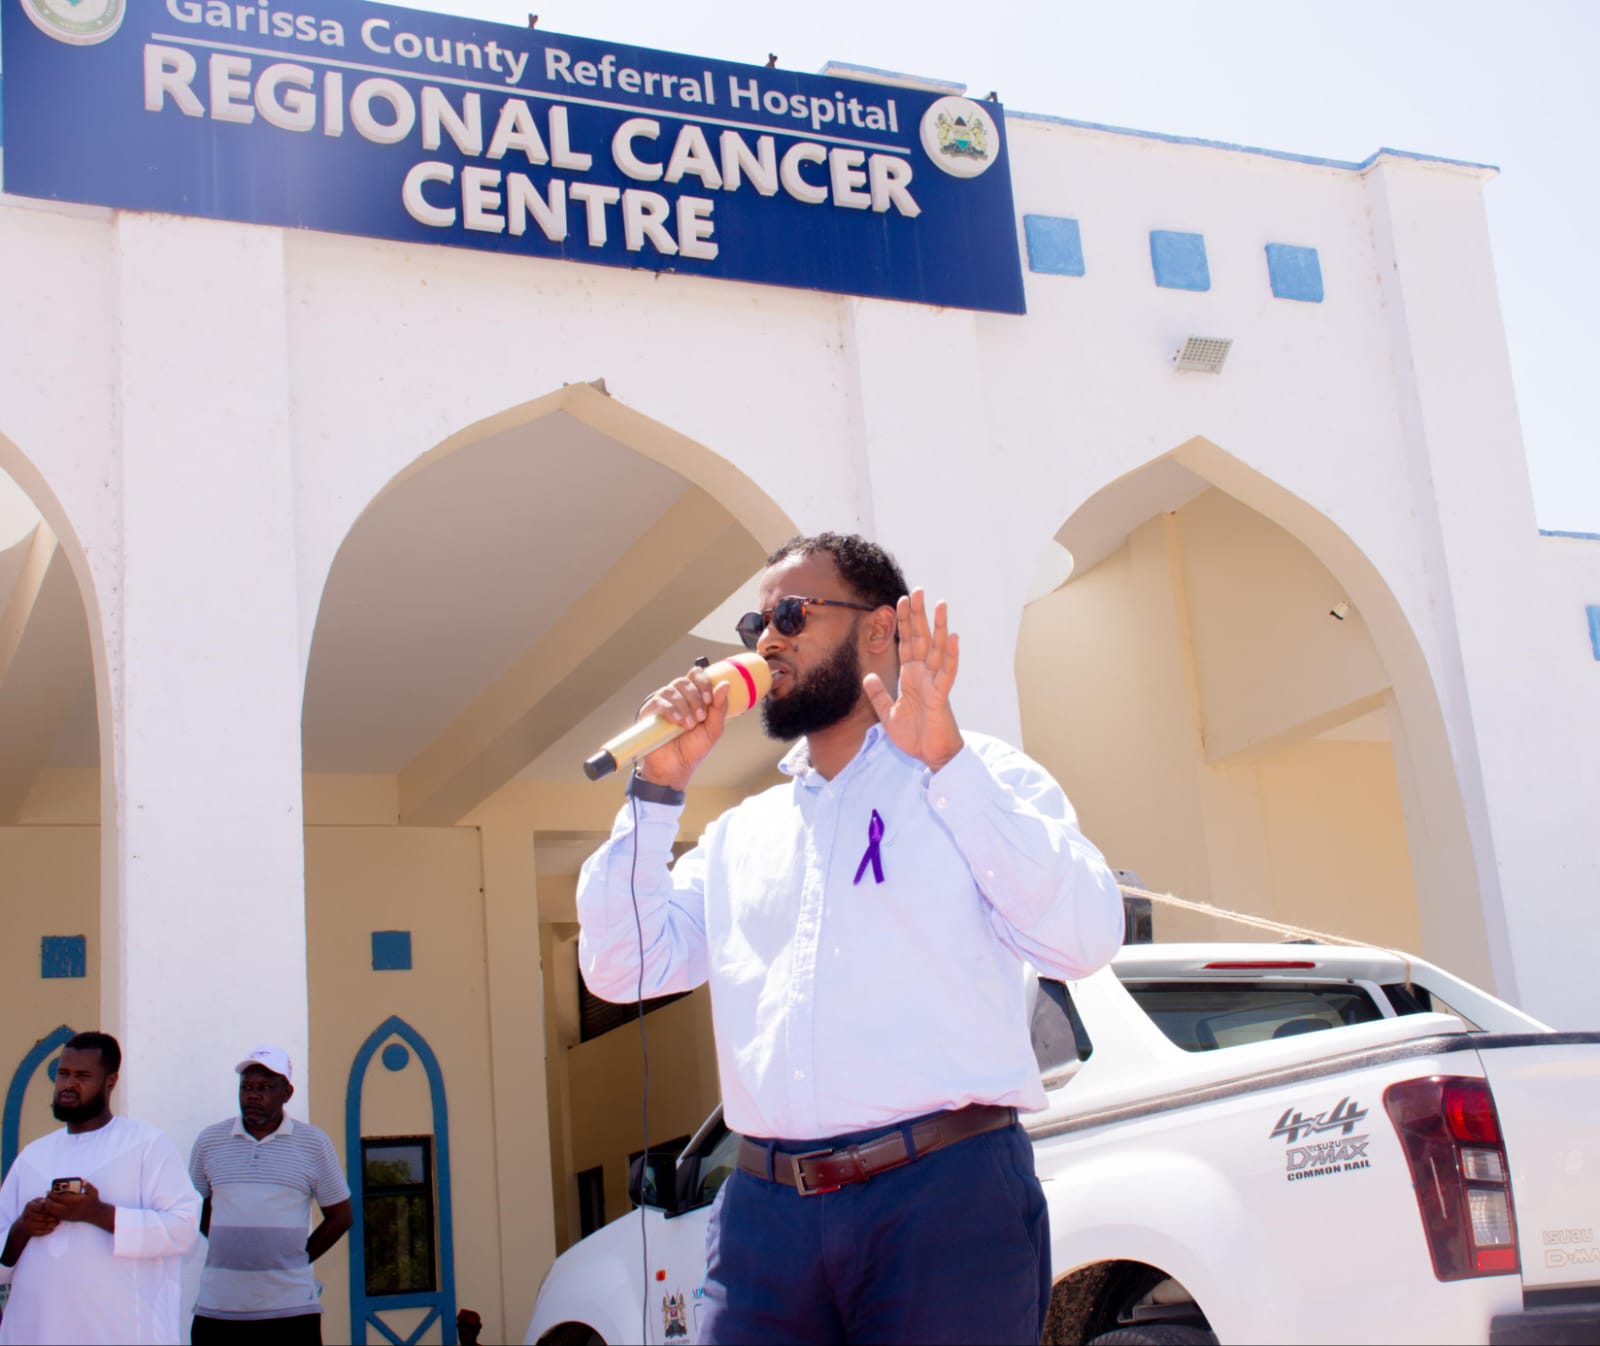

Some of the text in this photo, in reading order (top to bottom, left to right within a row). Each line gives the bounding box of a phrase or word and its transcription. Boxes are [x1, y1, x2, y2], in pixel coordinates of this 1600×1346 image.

[165, 0, 346, 48] Garissa
[360, 18, 530, 85] County
[544, 47, 715, 105] Referral
[729, 75, 900, 134] Hospital
[143, 43, 922, 219] REGIONAL CANCER
[402, 161, 719, 261] CENTRE
[1269, 1097, 1369, 1144] 4x4
[1314, 1140, 1341, 1151] ISUZU
[1287, 1159, 1371, 1181] COMMON RAIL
[1542, 1228, 1593, 1245] ISUZU
